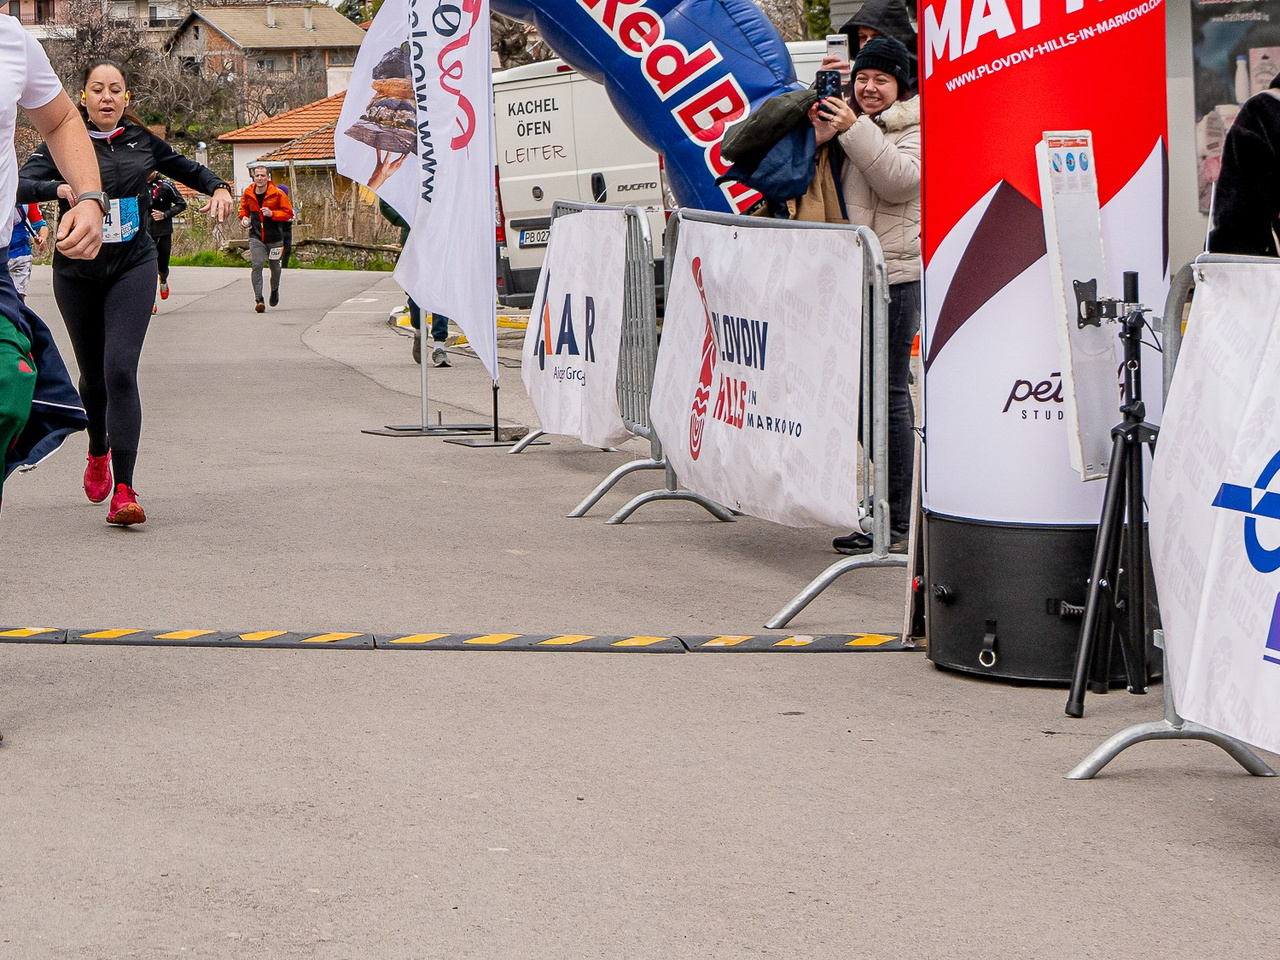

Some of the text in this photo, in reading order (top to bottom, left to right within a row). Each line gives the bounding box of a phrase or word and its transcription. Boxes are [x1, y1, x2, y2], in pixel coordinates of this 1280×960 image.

[508, 97, 559, 116] KACHEL
[517, 120, 551, 137] ÖFEN
[505, 144, 567, 164] LEITER
[617, 182, 657, 192] DUCATO
[525, 231, 551, 243] PB 027
[748, 390, 757, 405] IN
[1021, 409, 1064, 420] STUD
[747, 413, 802, 437] MARKOVO
